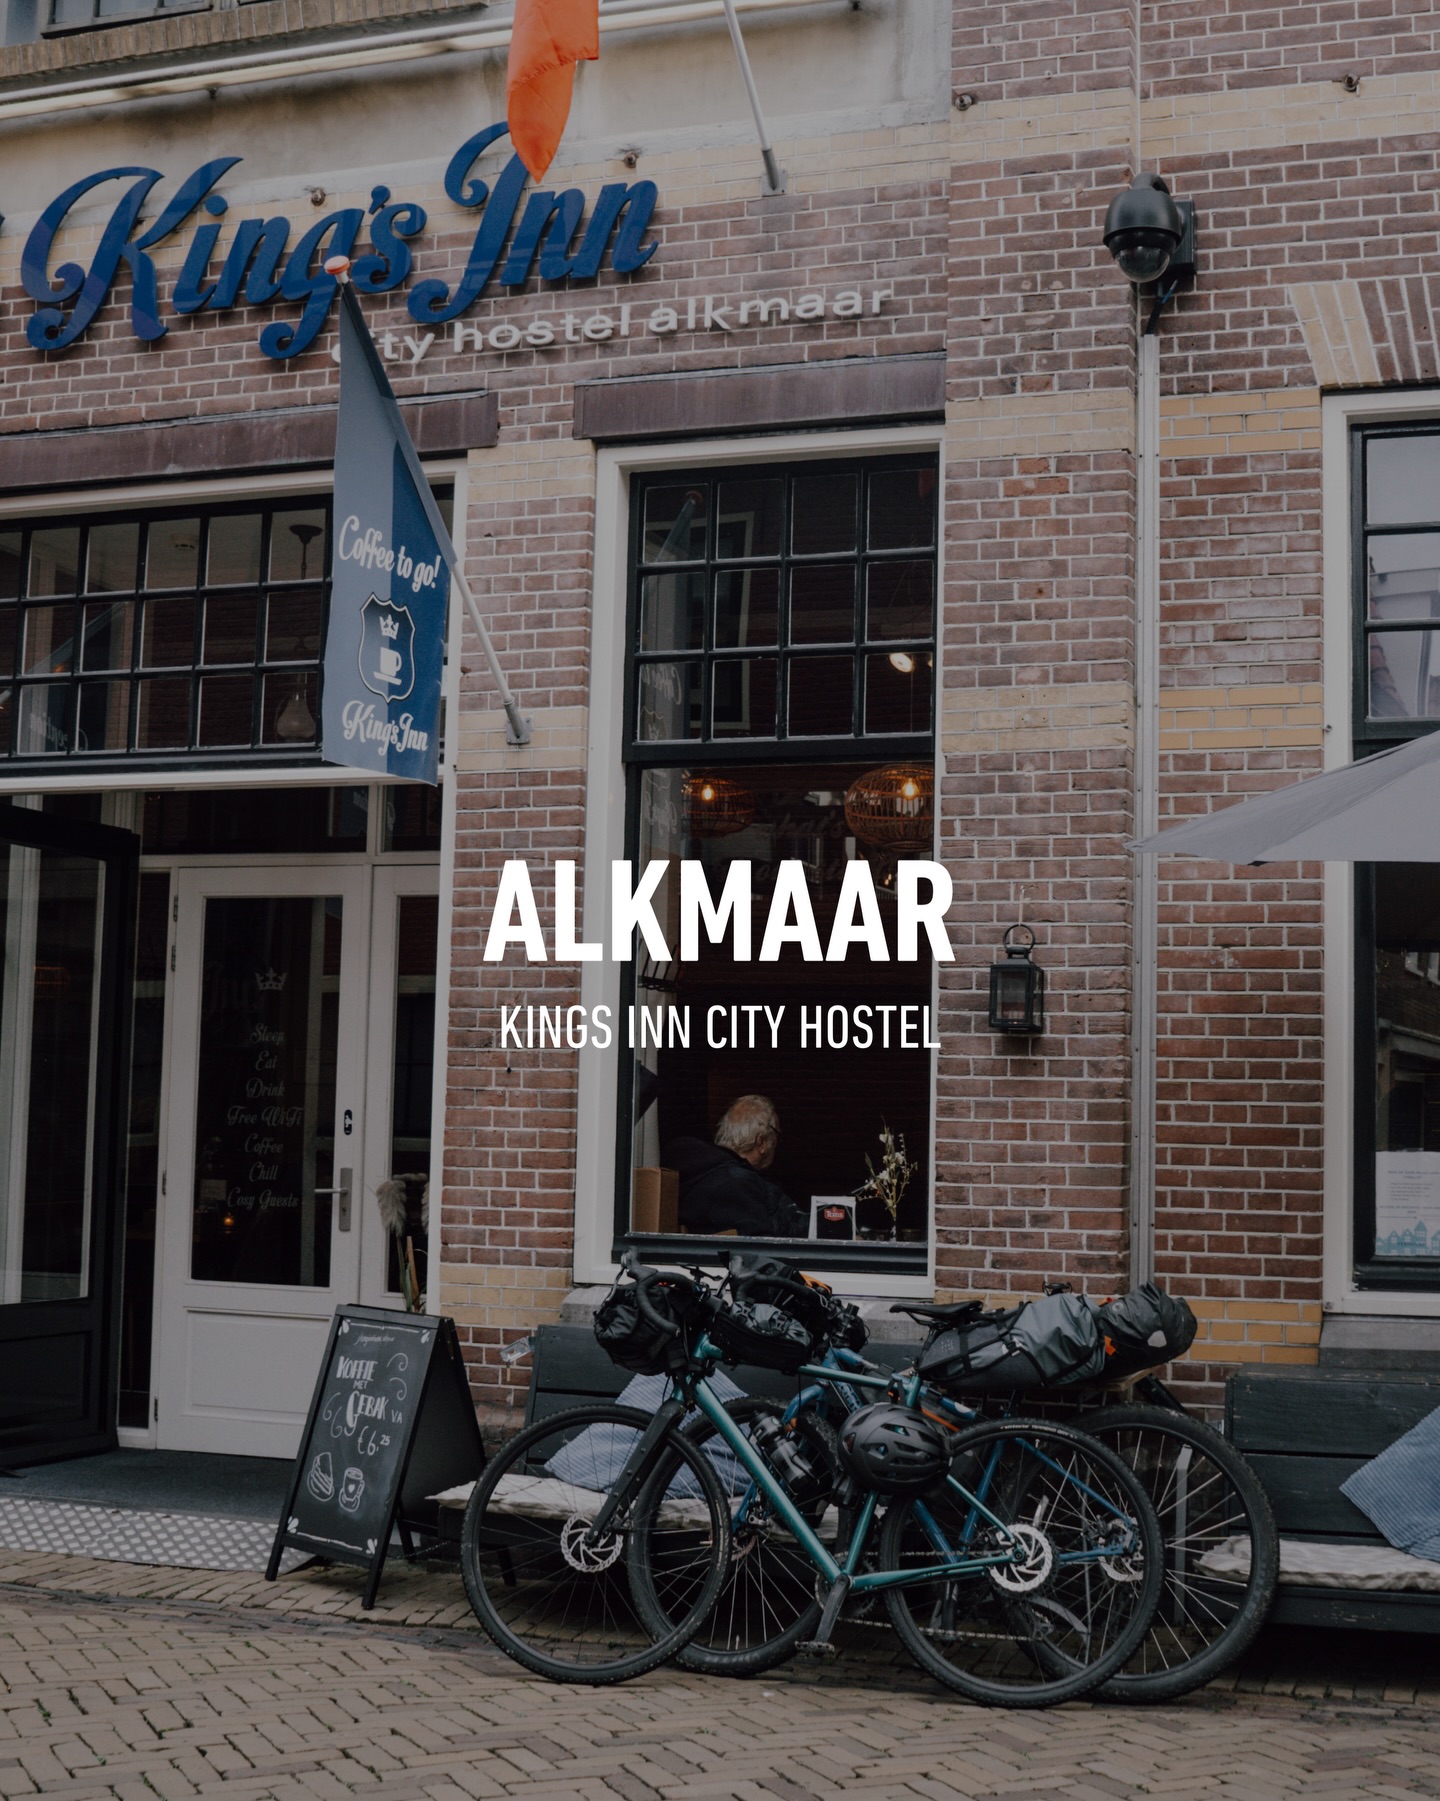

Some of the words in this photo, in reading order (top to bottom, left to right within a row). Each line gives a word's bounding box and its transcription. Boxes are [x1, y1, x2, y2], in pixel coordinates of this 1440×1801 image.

[21, 156, 427, 360] King's
[406, 121, 658, 324] Inn
[331, 329, 436, 365] ty
[454, 304, 631, 353] hostel
[648, 288, 894, 335] alkmaar
[339, 515, 395, 571] Coffee
[396, 545, 413, 579] to
[413, 554, 442, 593] go!
[342, 700, 399, 756] King's
[397, 712, 428, 753] Inn
[250, 1022, 285, 1046] Sleep
[255, 1050, 278, 1071] Eat
[246, 1077, 284, 1098] Drink
[227, 1105, 257, 1126] Free
[244, 1132, 284, 1156] Coffee
[249, 1161, 279, 1183] Chill
[227, 1186, 256, 1211] Cosy
[259, 1188, 299, 1211] Guests
[336, 1355, 378, 1381] KOFFIE
[353, 1380, 368, 1389] MET
[344, 1390, 389, 1436] GEBAK
